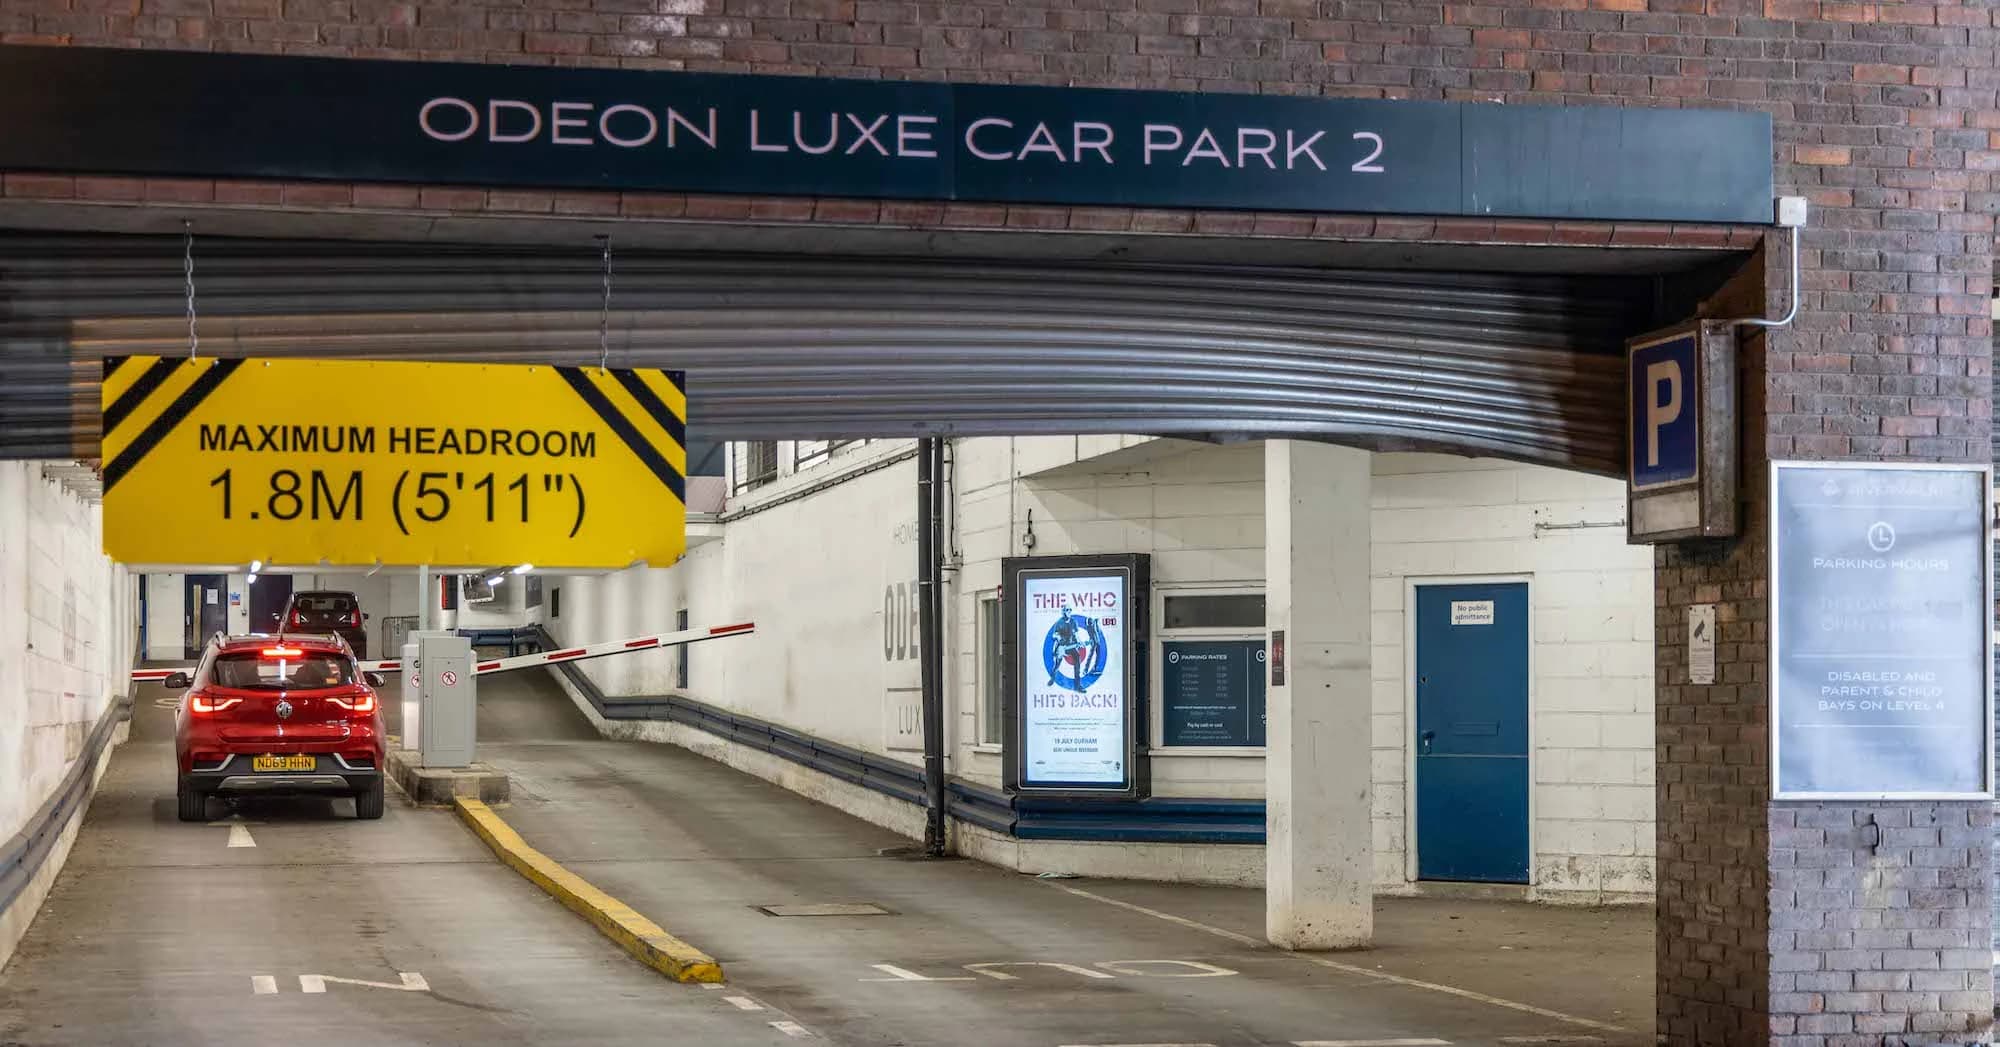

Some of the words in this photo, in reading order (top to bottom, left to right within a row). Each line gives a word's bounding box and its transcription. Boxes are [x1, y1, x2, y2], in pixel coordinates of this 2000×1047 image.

[419, 97, 717, 150] ODEON
[750, 109, 937, 158] LUXE
[964, 117, 1113, 165] CAR
[1143, 124, 1327, 171] PARK
[1351, 131, 1385, 173] 2
[1647, 359, 1683, 467] P
[200, 423, 375, 453] MAXIMUM
[388, 427, 597, 458] HEADROOM
[210, 468, 364, 521] 1.8M
[391, 470, 586, 539] (5'11")
[1813, 558, 1885, 569] PARKING
[1891, 559, 1949, 570] HOURS
[1033, 593, 1066, 608] THE
[1072, 592, 1117, 607] WHO
[1828, 671, 1900, 681] DISABLED
[1904, 671, 1936, 681] AND
[1821, 686, 1879, 696] PARENT
[1883, 686, 1894, 696] &
[1898, 686, 1942, 697] CHILD
[1033, 694, 1066, 708] HITS
[1071, 693, 1118, 708] BACK!
[1818, 700, 1856, 711] BAYS
[1859, 700, 1882, 711] ON
[1887, 701, 1932, 711] LEVEL
[257, 759, 286, 768] ND69
[289, 759, 312, 768] HHN
